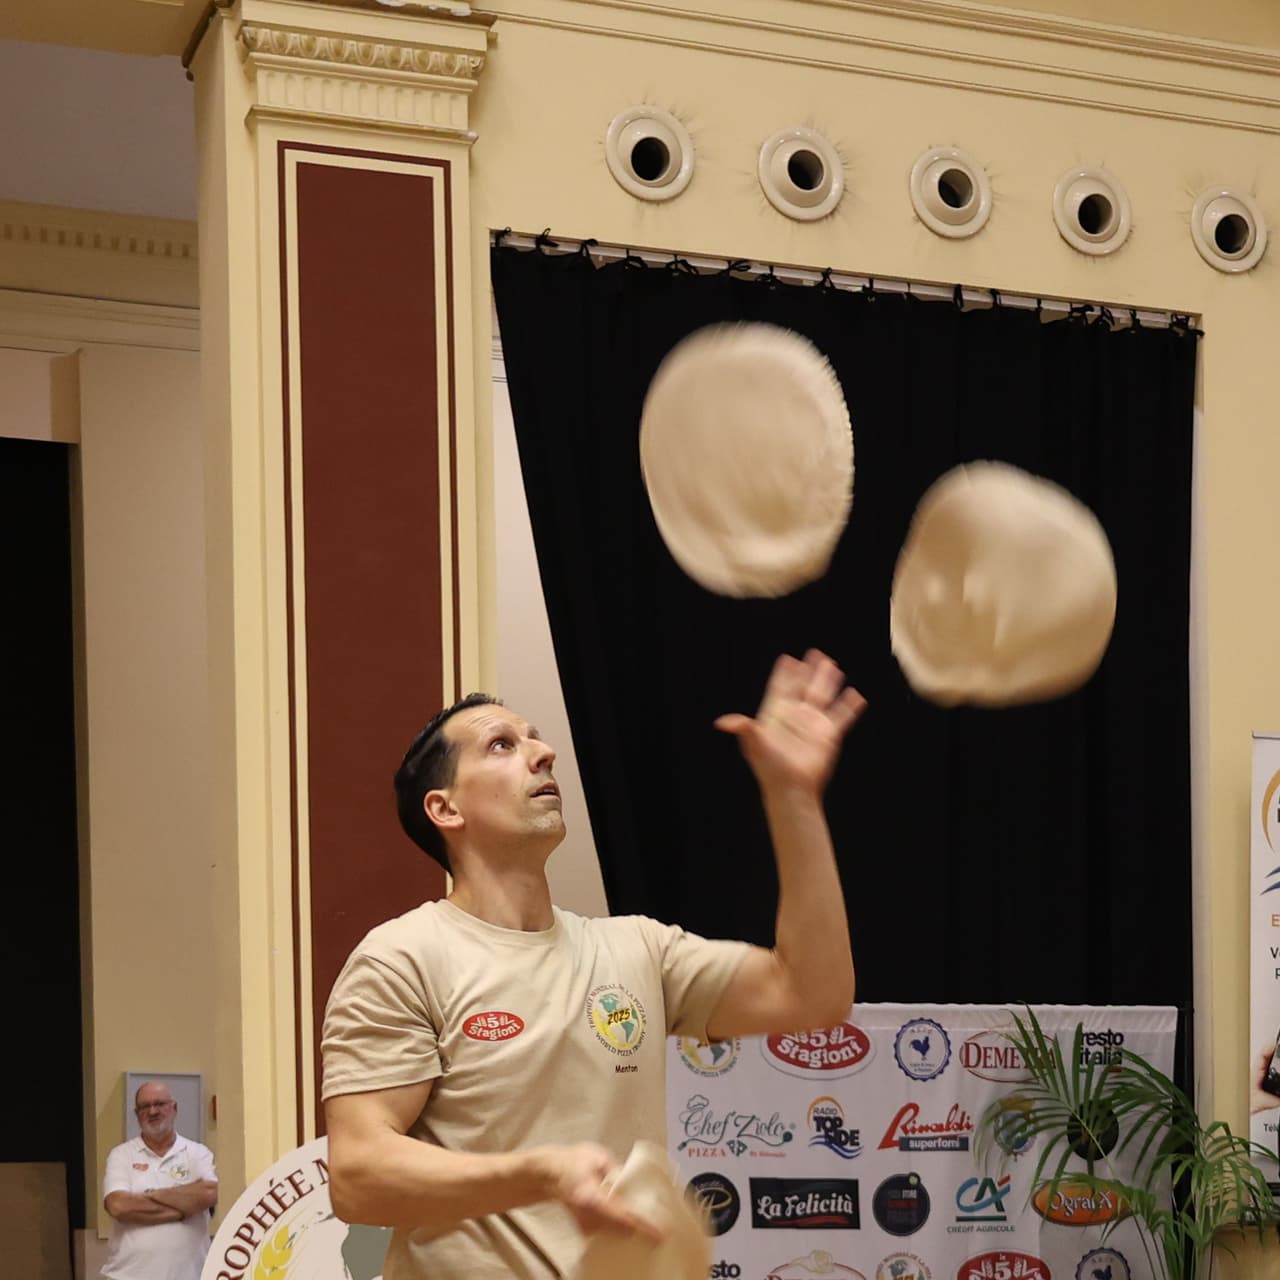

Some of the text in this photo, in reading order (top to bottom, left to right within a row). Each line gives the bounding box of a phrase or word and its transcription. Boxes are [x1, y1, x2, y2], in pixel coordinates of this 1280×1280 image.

[607, 1008, 631, 1025] 2025
[809, 1028, 827, 1048] 5
[1081, 1028, 1124, 1047] resto
[776, 1040, 864, 1068] Stagioni
[615, 1065, 638, 1073] Menton
[813, 1107, 838, 1116] RADIO
[679, 1110, 735, 1145] Chef
[813, 1116, 843, 1133] TOP
[878, 1102, 973, 1151] Rinaldi
[688, 1148, 727, 1158] PIZZA
[757, 1193, 854, 1219] La Felicità
[976, 1224, 1016, 1233] AGRICOLE
[710, 1260, 741, 1279] sto
[993, 1260, 1011, 1280] 5
